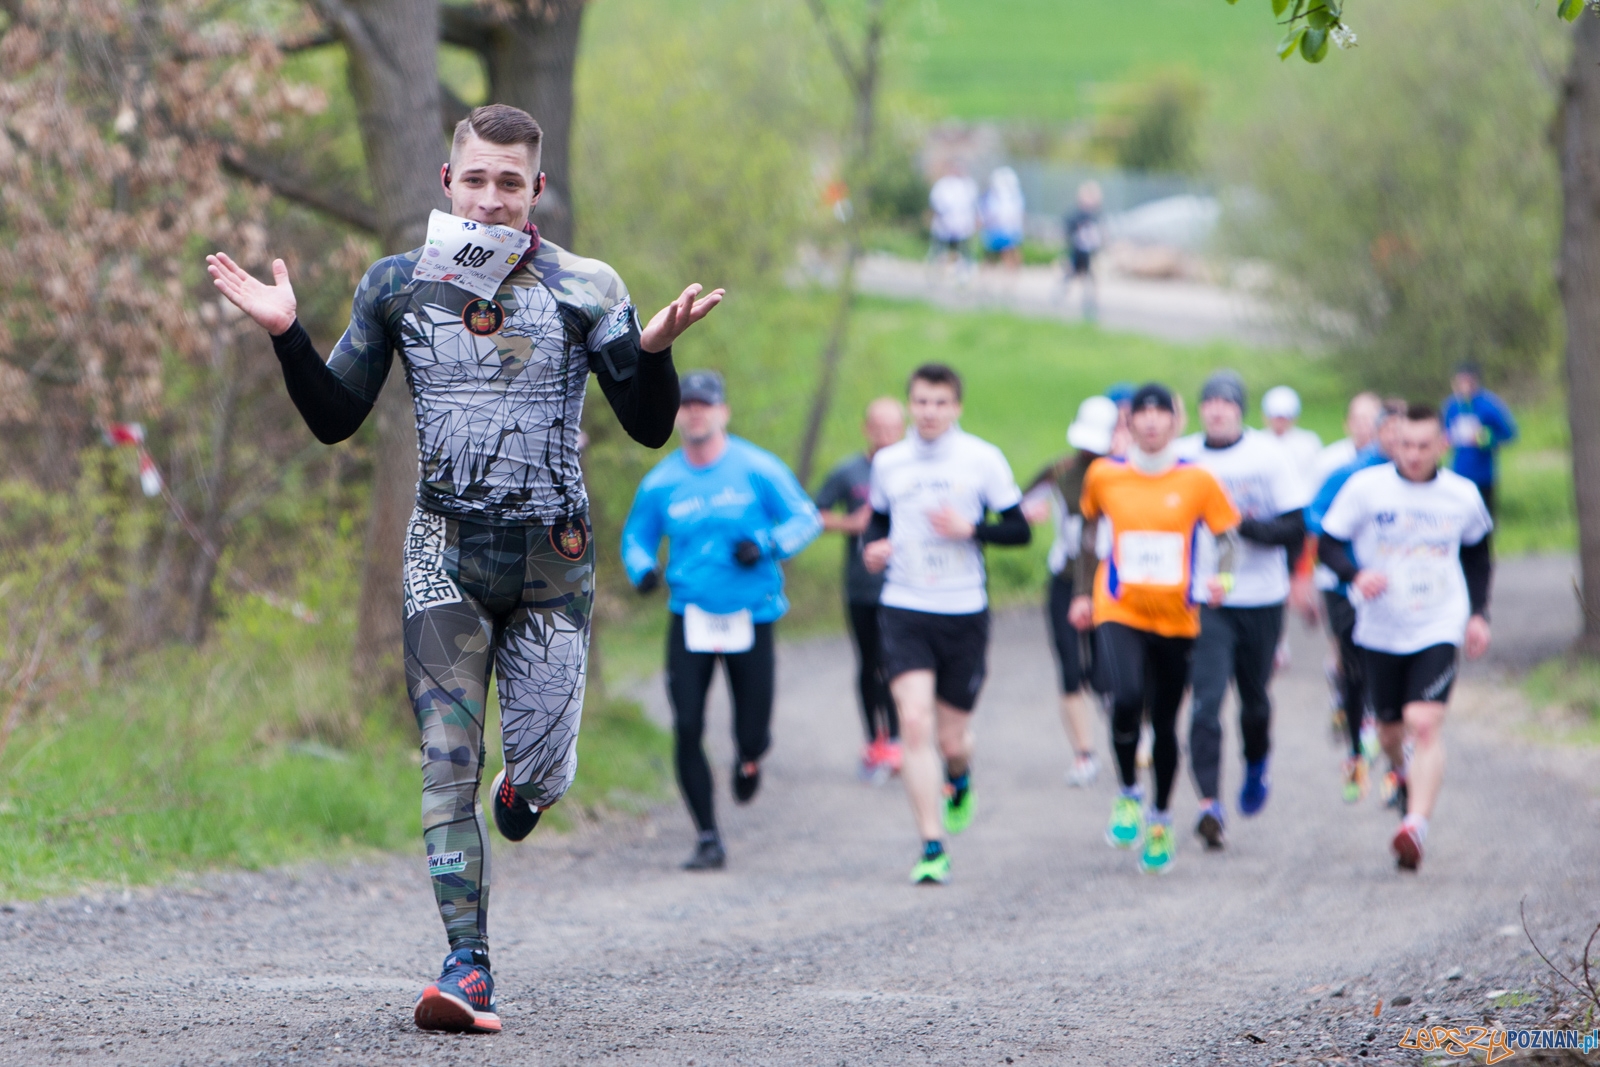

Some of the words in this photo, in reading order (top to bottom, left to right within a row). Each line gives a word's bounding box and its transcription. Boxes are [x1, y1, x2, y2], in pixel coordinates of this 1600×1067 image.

[453, 242, 494, 268] 498
[434, 263, 448, 272] 5KM
[470, 270, 487, 280] 10KM
